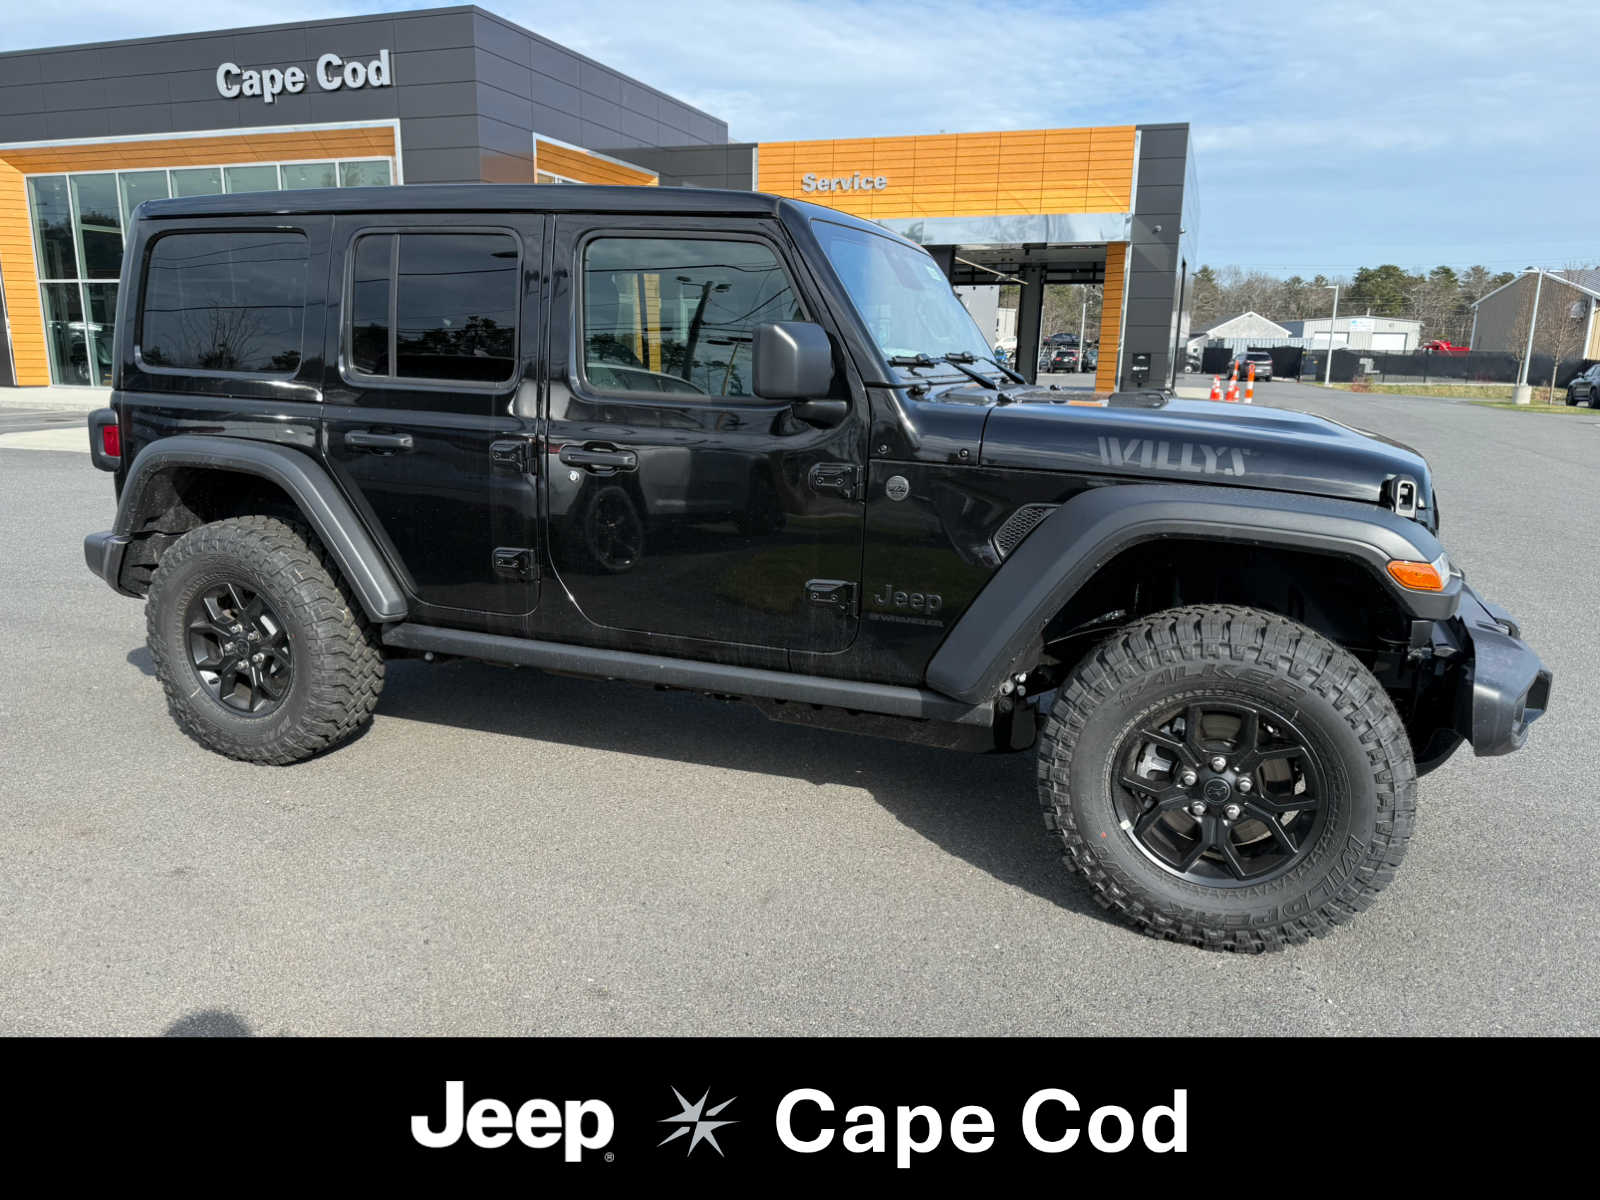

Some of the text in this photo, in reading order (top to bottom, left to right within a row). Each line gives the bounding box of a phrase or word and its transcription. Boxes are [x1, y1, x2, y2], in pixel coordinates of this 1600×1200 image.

[216, 49, 392, 103] Cape Cod
[801, 171, 888, 192] Service
[1097, 437, 1260, 477] WILLYS
[873, 584, 942, 615] Jeep
